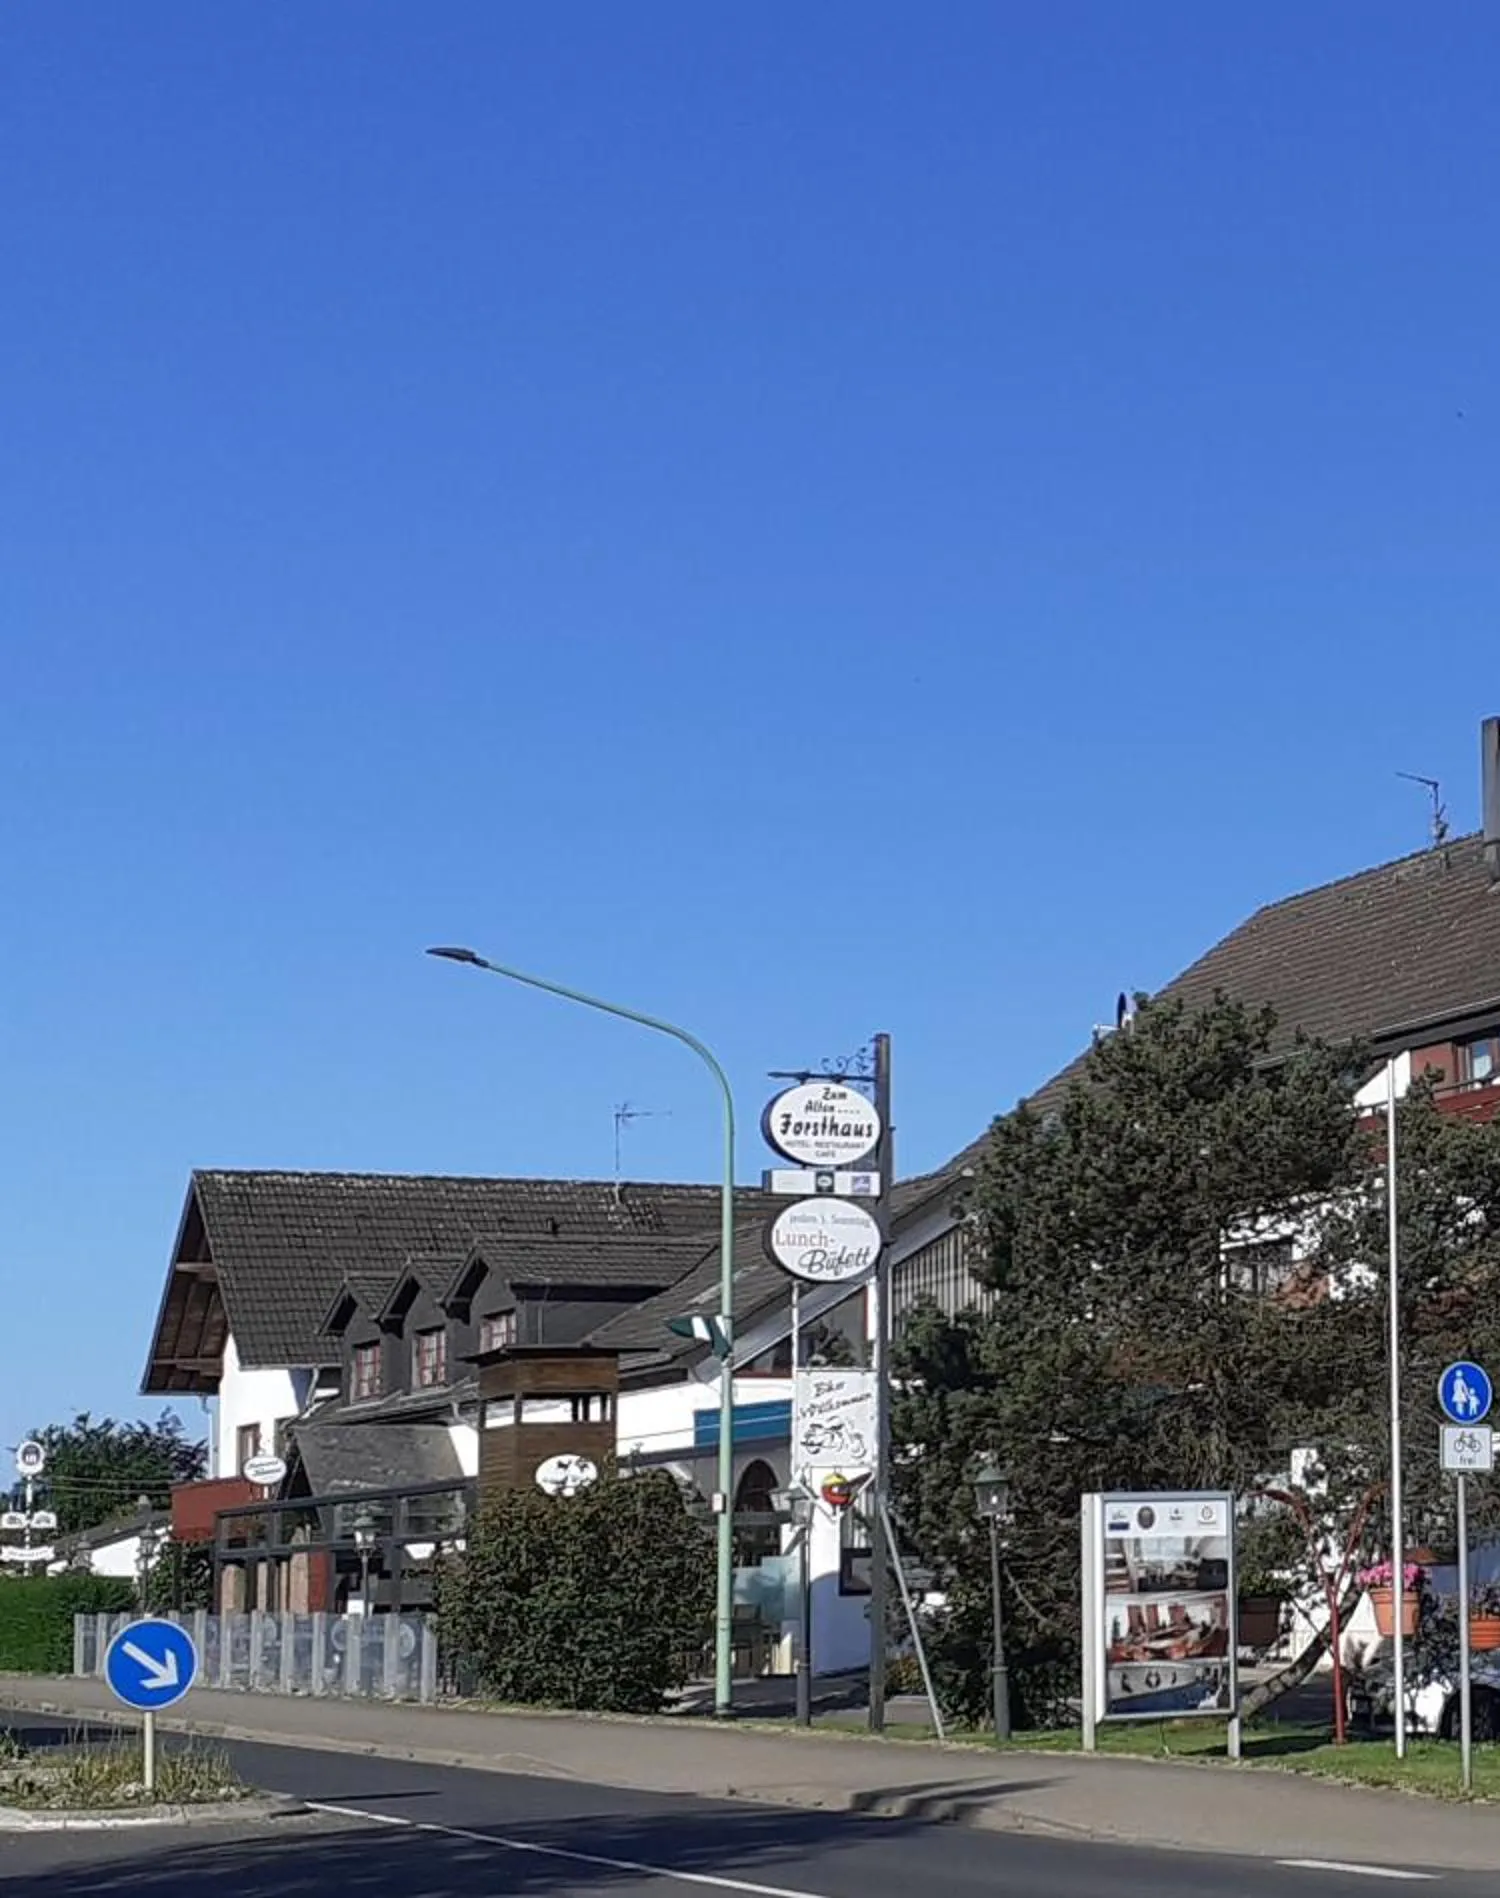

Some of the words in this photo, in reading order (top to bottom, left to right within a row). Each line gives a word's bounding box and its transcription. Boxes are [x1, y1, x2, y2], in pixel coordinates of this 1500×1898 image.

[822, 1087, 848, 1101] Zum
[804, 1099, 835, 1114] Alten
[780, 1112, 873, 1137] Forsthaus
